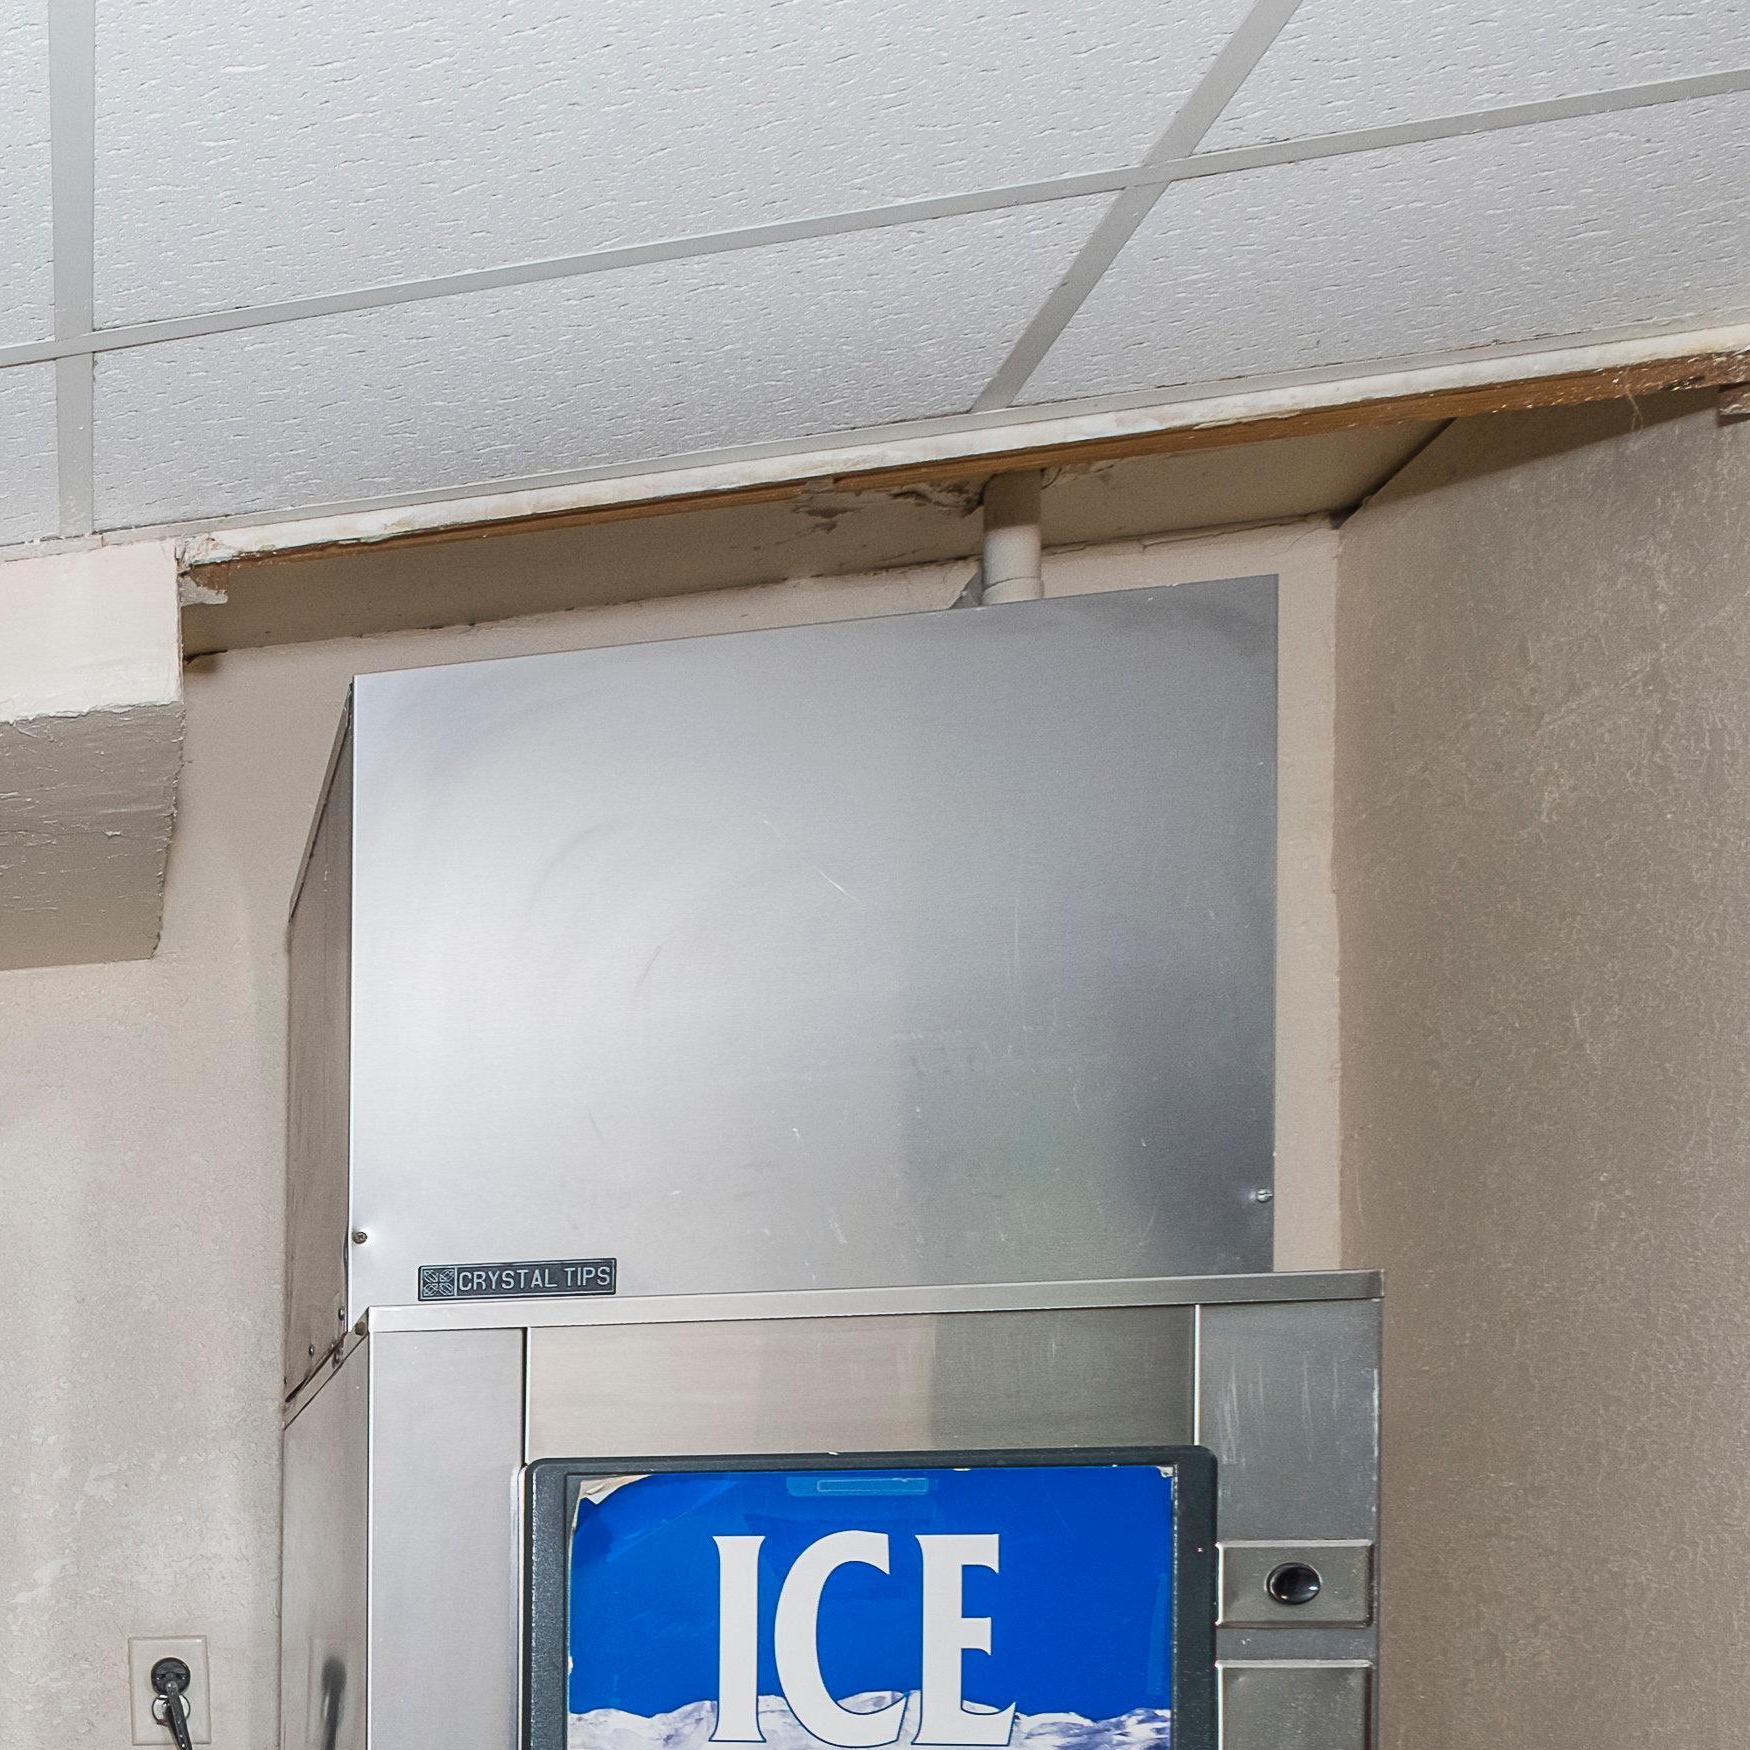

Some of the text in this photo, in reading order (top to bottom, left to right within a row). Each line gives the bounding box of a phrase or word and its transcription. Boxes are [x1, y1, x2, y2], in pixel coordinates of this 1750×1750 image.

[459, 1267, 610, 1291] CRYSTAL TIPS
[707, 1530, 1017, 1748] ICE
